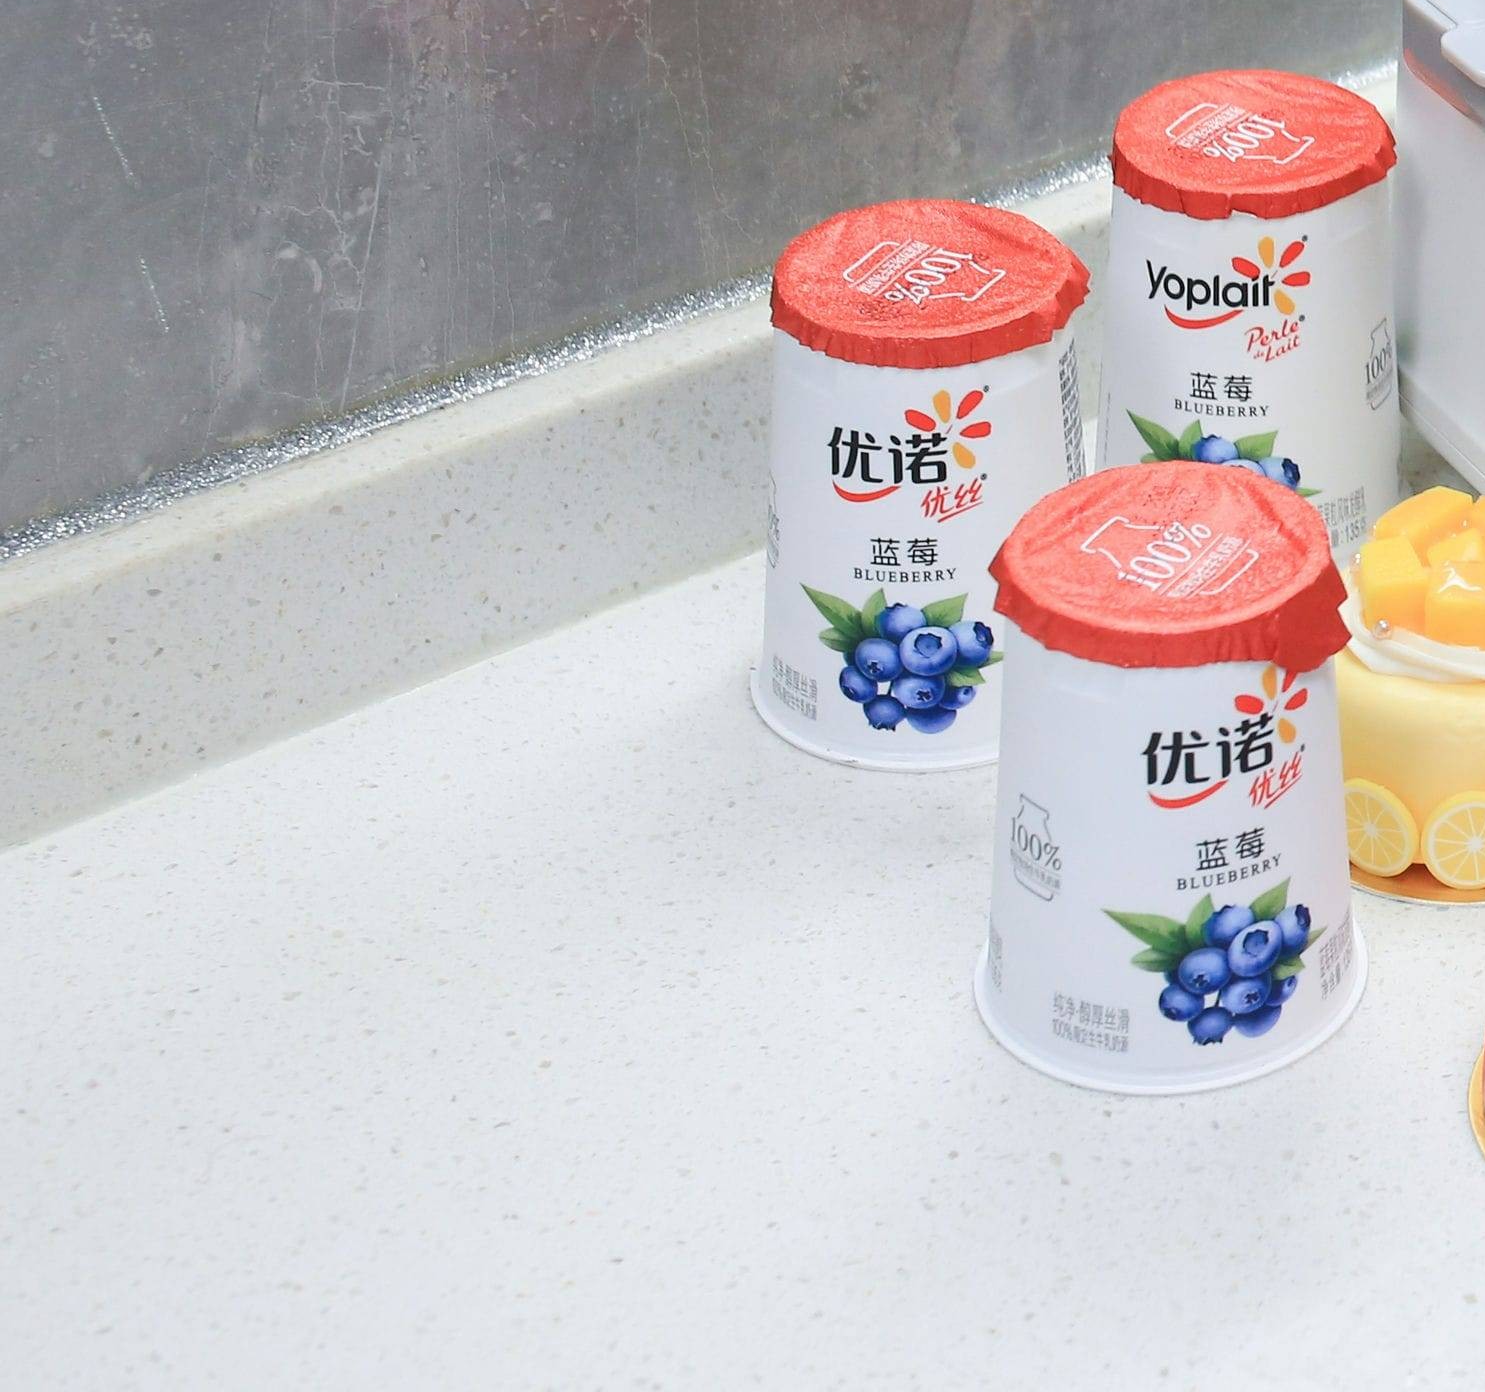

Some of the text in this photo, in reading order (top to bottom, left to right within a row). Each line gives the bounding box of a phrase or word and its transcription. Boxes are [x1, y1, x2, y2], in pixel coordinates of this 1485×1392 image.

[1146, 259, 1276, 312] Yoplait
[1244, 319, 1299, 353] Perle
[1264, 336, 1301, 362] Lait
[1173, 397, 1270, 418] BLUEBERRY
[1189, 371, 1253, 402] 蓝莓
[827, 426, 948, 485] 优诺
[920, 477, 984, 522] 优丝
[869, 537, 939, 567] 蓝莓
[1117, 520, 1213, 592] 100%
[853, 567, 958, 584] BLUEBERRY
[1141, 712, 1275, 786] 优诺
[1248, 750, 1304, 808] 优丝
[1010, 816, 1062, 872] 100%
[1195, 827, 1265, 872] 蓝莓
[1176, 853, 1282, 892] BLUEBERRY
